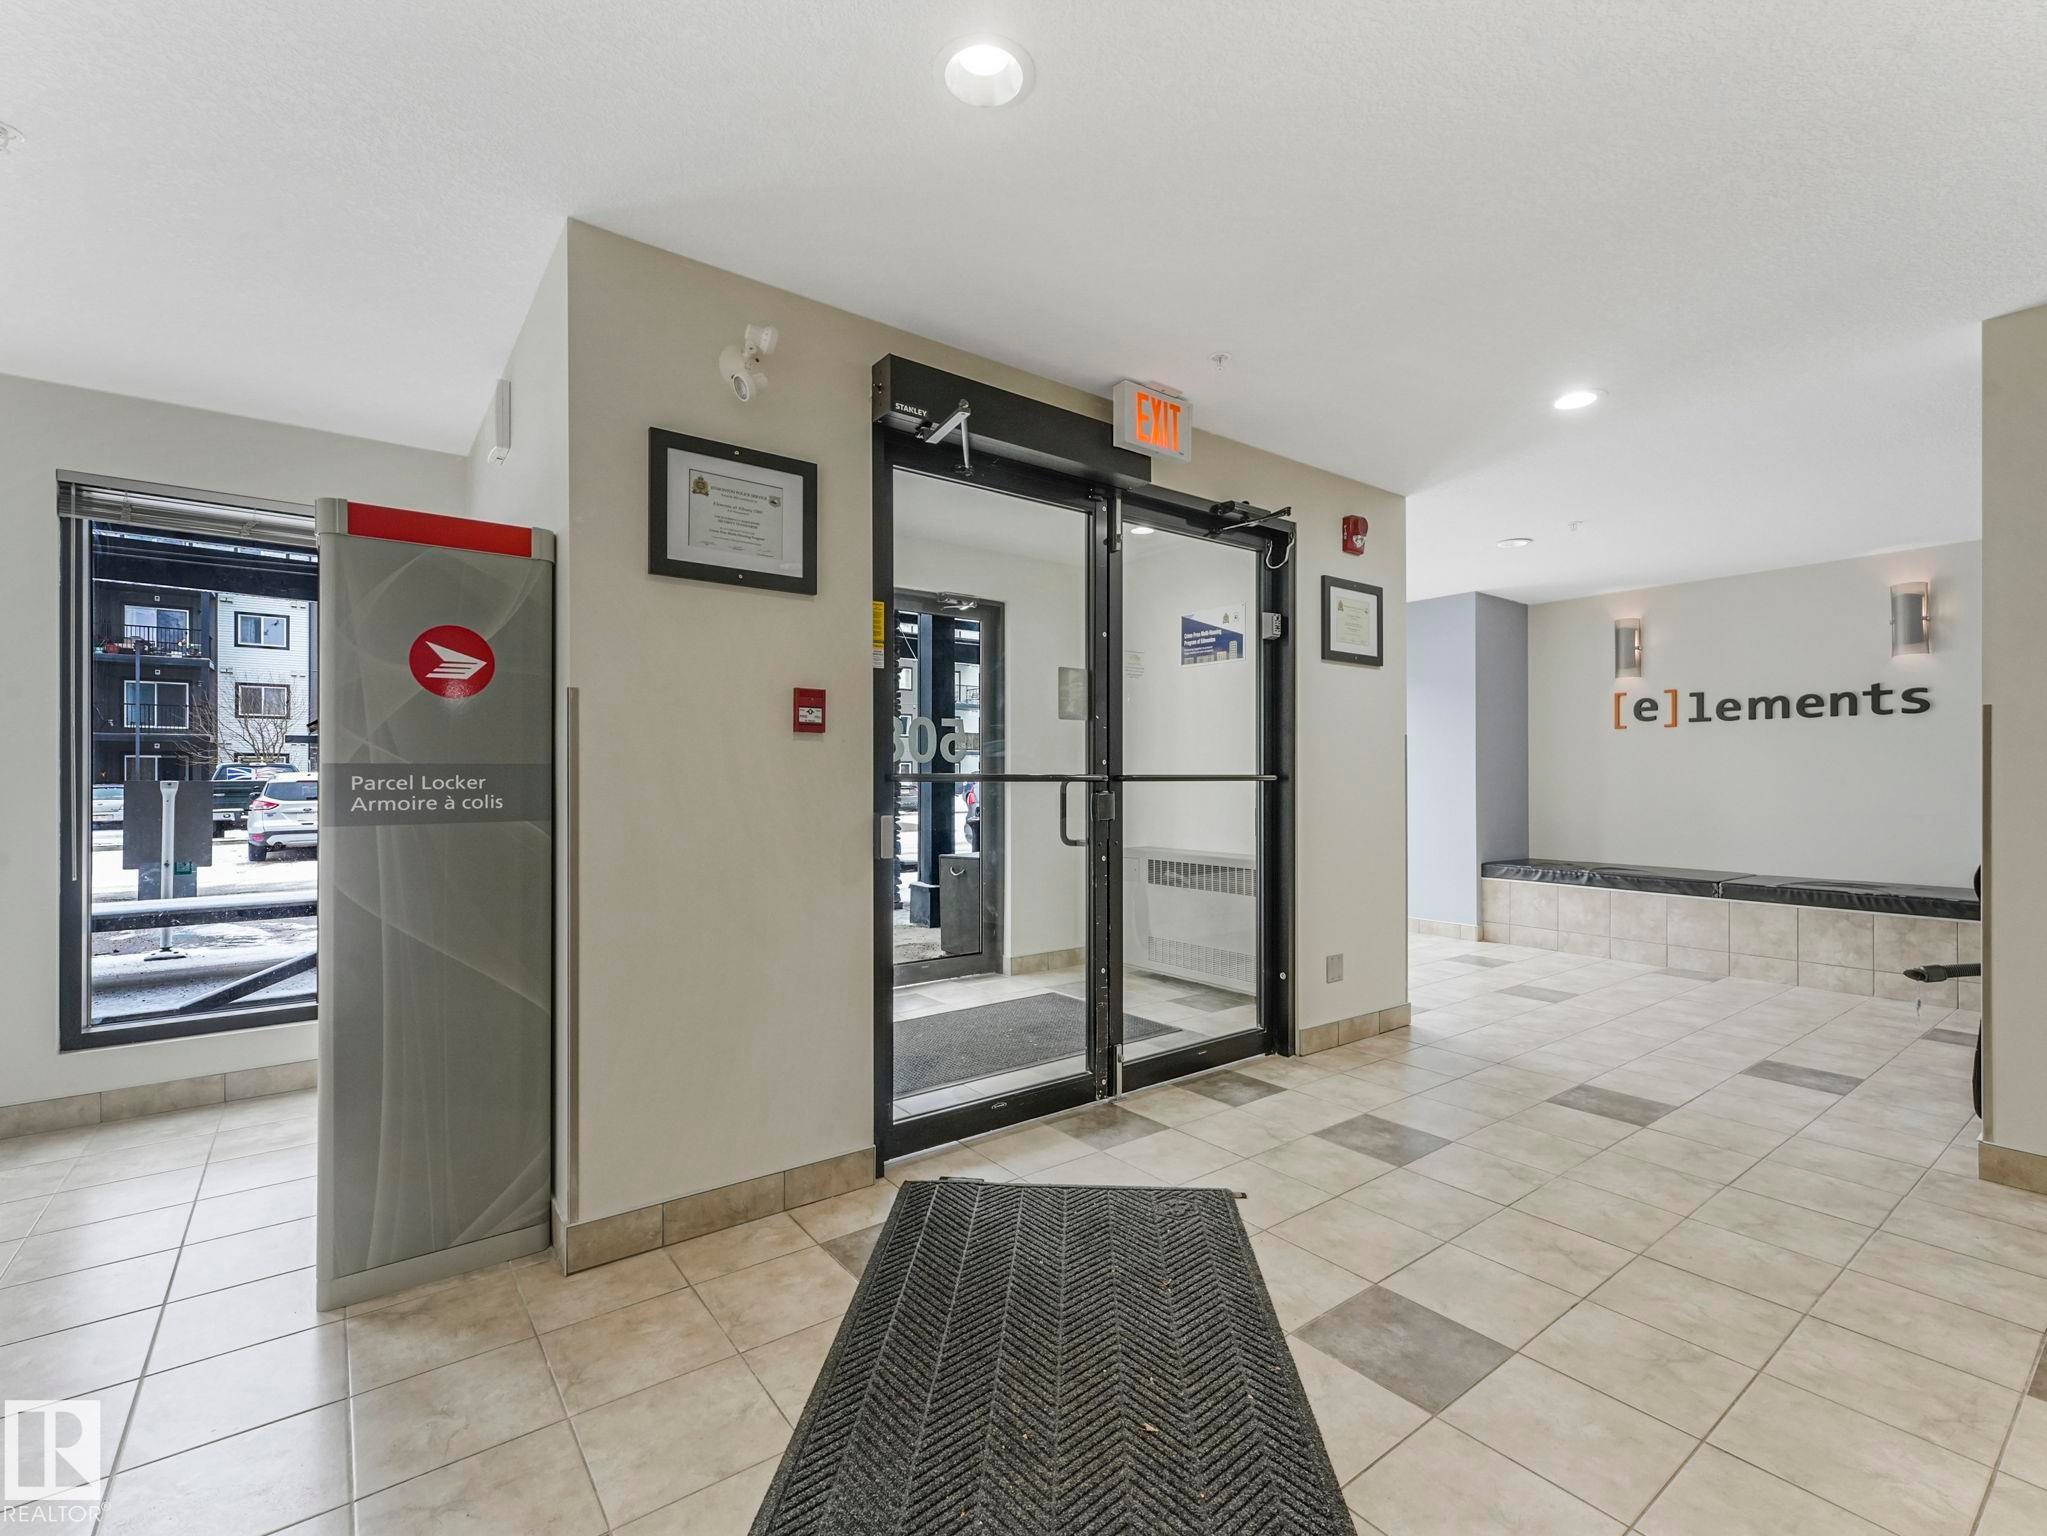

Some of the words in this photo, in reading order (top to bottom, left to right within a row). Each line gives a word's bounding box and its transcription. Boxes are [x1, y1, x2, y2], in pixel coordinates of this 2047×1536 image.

[895, 402, 928, 417] STANLEY
[1136, 392, 1181, 453] EXIT
[351, 775, 414, 791] Parcel
[421, 774, 487, 790] Locker
[350, 796, 438, 812] Armoire
[444, 795, 456, 810] à
[462, 794, 504, 810] colis
